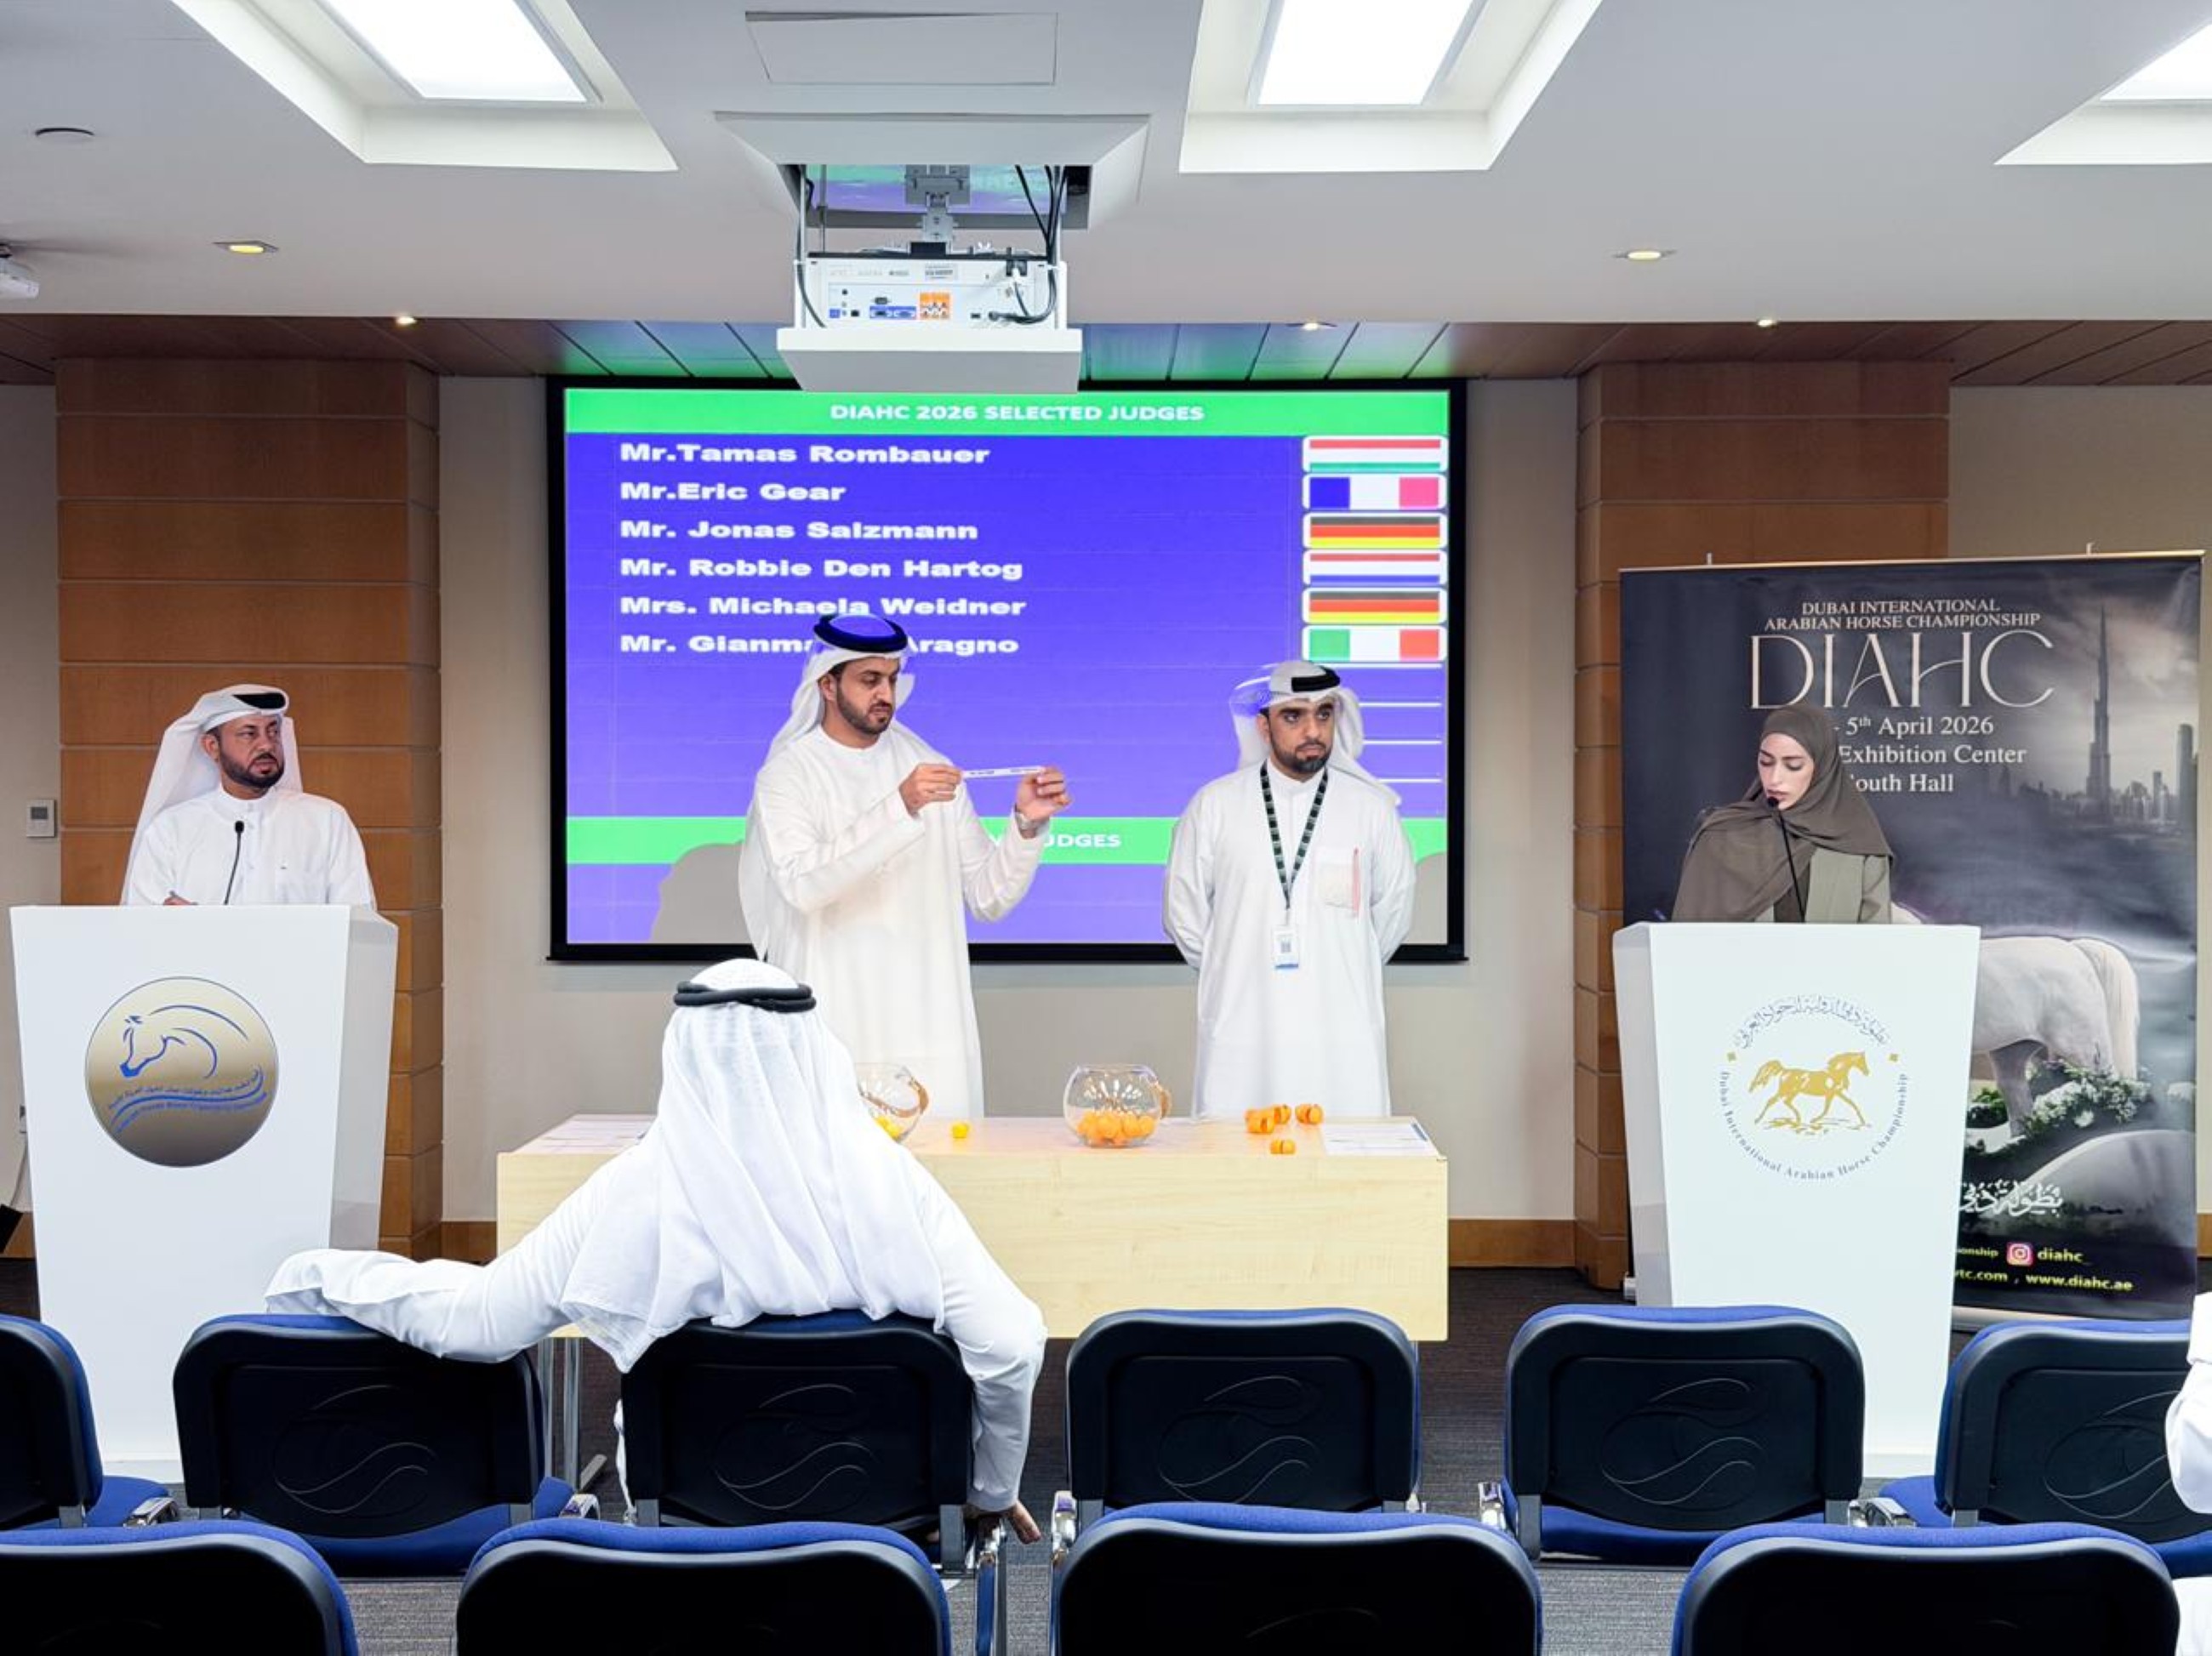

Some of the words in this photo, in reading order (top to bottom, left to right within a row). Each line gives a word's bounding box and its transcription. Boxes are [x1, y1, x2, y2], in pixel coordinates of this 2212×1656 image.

[830, 404, 909, 419] DIAHC
[916, 405, 978, 420] 2026
[984, 406, 1103, 421] SELECTED
[1109, 406, 1205, 421] JUDGES
[620, 443, 797, 464] Mr.Tamas
[810, 445, 990, 464] Rombauer
[620, 481, 748, 500] Mr.Eric
[760, 483, 847, 501] Gear
[620, 520, 676, 538] Mr.
[687, 521, 795, 538] Jonas
[807, 521, 978, 540] Salzmann
[620, 558, 676, 577] Mr.
[689, 559, 812, 577] Robbie
[824, 559, 892, 578] Den
[904, 560, 1023, 581] Hartog
[620, 597, 697, 614] Mrs.
[709, 597, 870, 616] Michaela
[881, 597, 1027, 616] Weidner
[1802, 601, 1855, 615] DUBAI
[1860, 599, 2000, 614] INTERNATIONAL
[1764, 617, 1842, 631] ARABIAN
[1845, 615, 1902, 629] HORSE
[1906, 612, 2042, 629] CHAMPIONSHIP
[620, 635, 677, 653] Mr.
[687, 635, 812, 654] Gianm
[1750, 629, 2055, 709] DIAHC
[1878, 715, 1933, 740] April
[1940, 715, 1995, 736] 2026
[1838, 744, 1947, 764] Exhibition
[1953, 743, 2027, 764] Center
[1850, 773, 1902, 793] outh
[1908, 772, 1954, 793] Hall
[1719, 1071, 1730, 1107] Dubai
[1724, 1109, 1782, 1173] International
[1785, 1167, 1834, 1181] Arabian
[2025, 1274, 2134, 1291] www.diahc.ae
